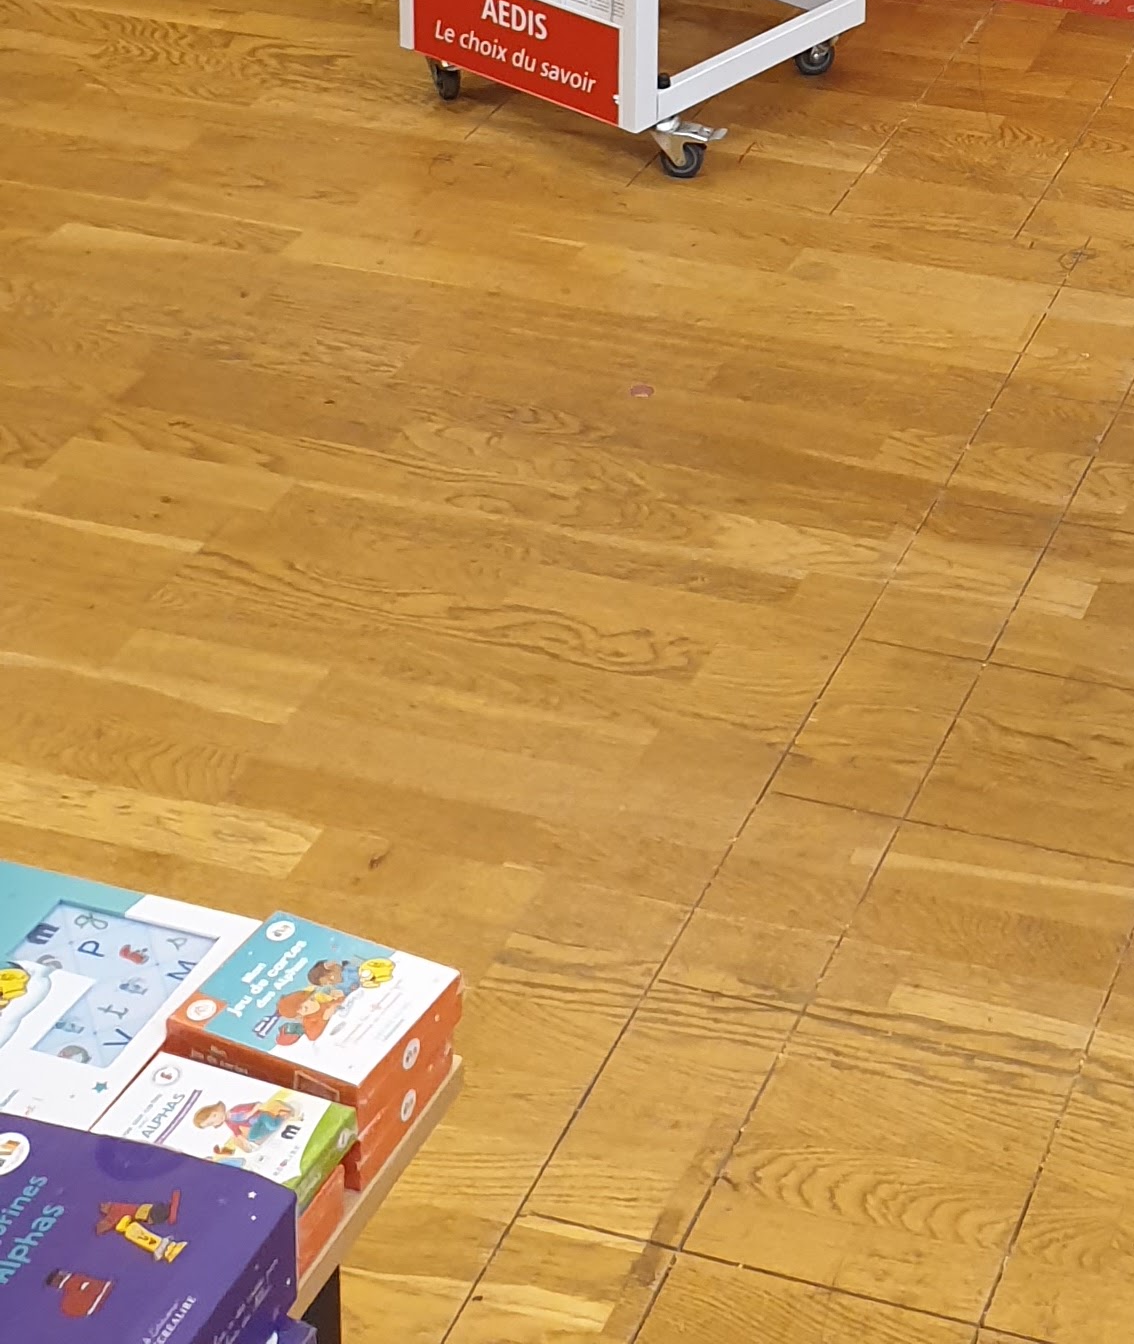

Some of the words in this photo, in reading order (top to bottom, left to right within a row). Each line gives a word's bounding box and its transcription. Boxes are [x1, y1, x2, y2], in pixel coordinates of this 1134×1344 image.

[435, 20, 455, 44] Le
[460, 32, 507, 62] choix
[512, 50, 536, 72] du
[540, 62, 596, 93] savoir
[141, 1093, 185, 1138] ALPHAS
